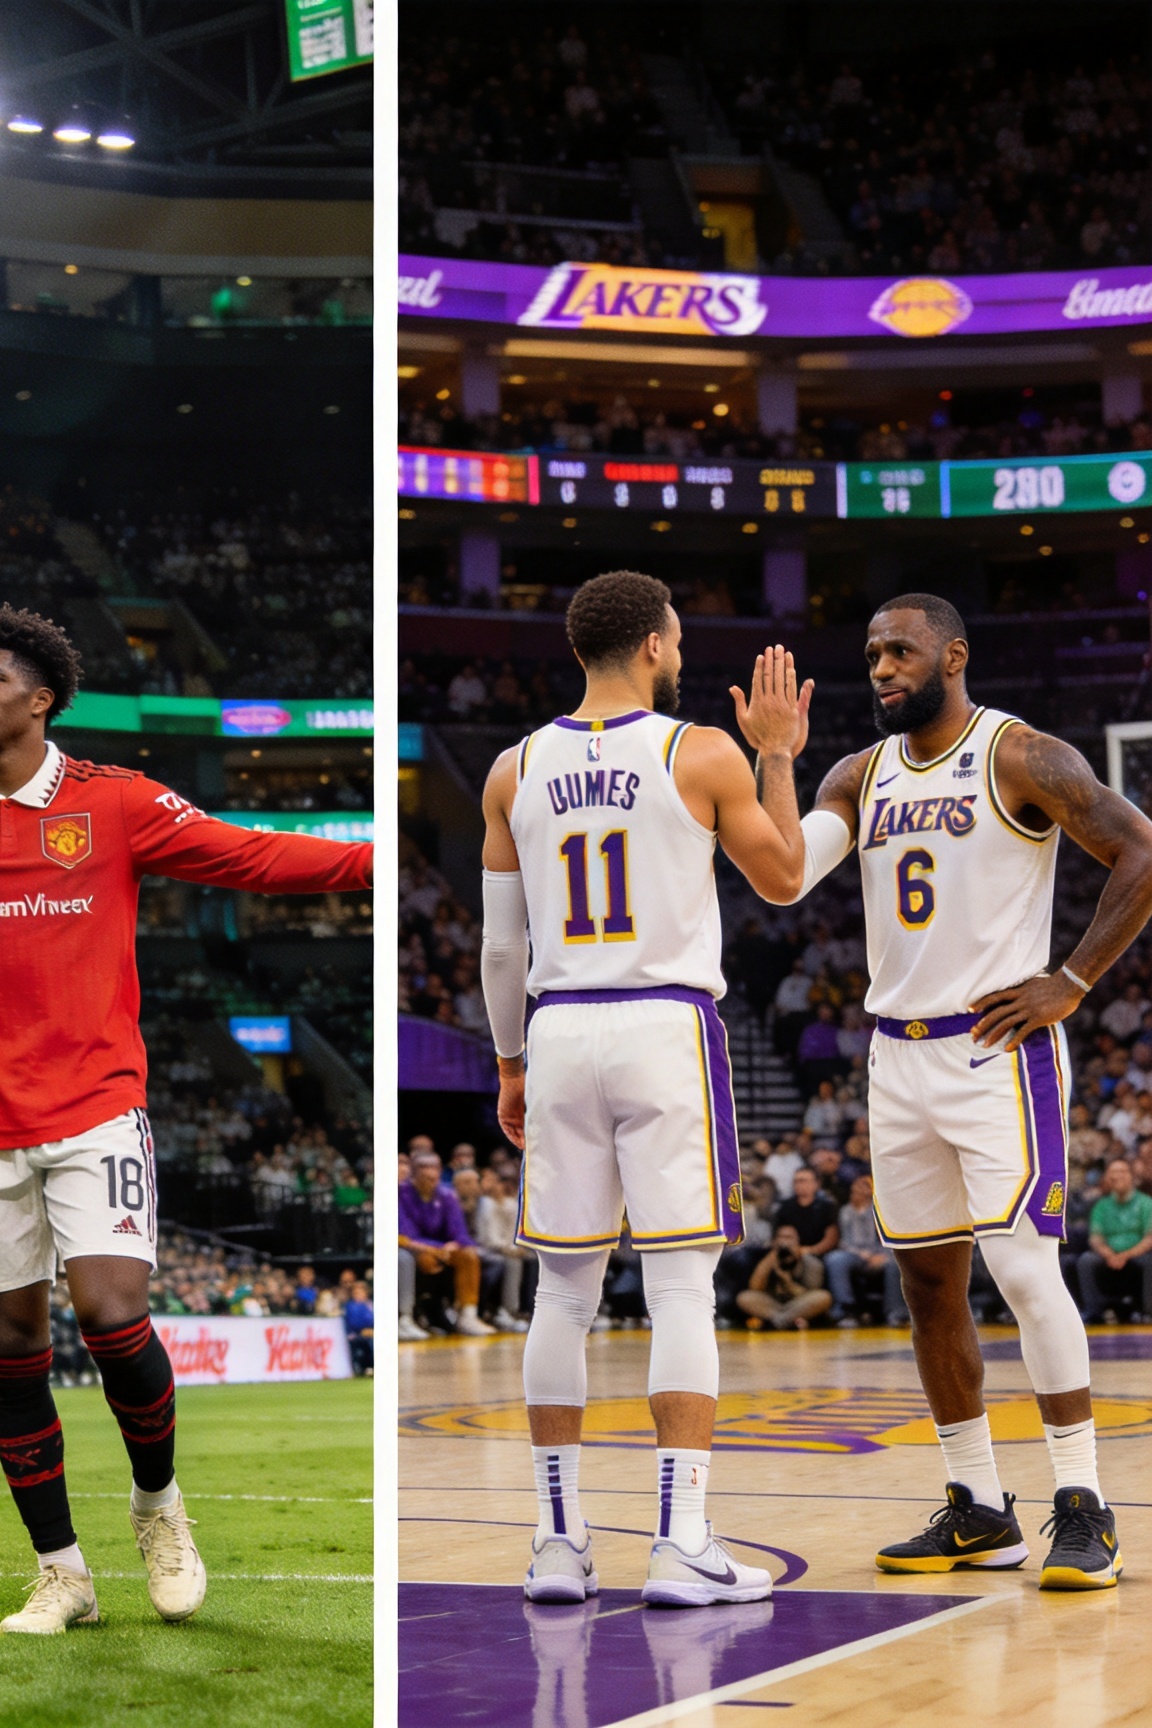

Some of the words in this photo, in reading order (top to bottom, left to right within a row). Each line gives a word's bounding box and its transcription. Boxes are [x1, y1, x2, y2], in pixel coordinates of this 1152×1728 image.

[530, 265, 758, 332] LAKERS
[862, 794, 978, 850] LAKERS
[559, 829, 637, 945] 11
[896, 846, 936, 931] 6
[100, 1155, 144, 1211] 18
